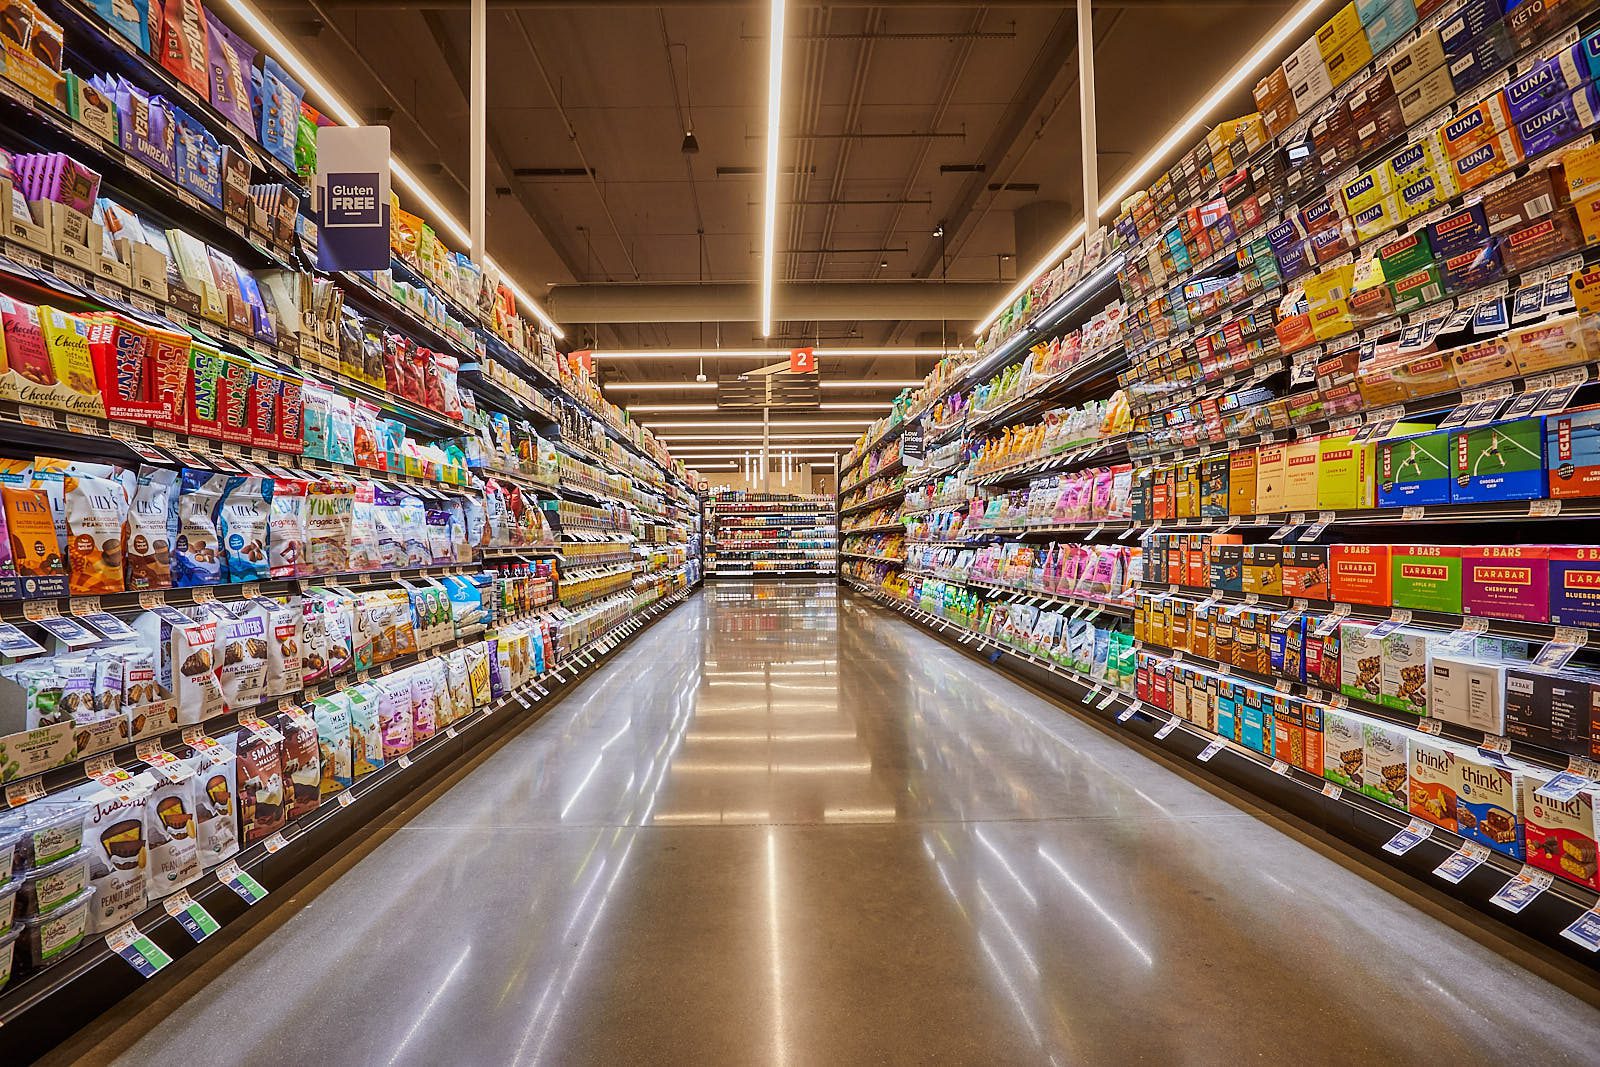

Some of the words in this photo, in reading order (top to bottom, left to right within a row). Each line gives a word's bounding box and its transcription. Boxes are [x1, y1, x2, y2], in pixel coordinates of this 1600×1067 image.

[1511, 1, 1543, 28] KETO
[226, 42, 251, 114] UNREAL
[1513, 71, 1549, 98] LUNA
[1449, 114, 1480, 137] LUNA
[1525, 108, 1561, 134] LUNA
[137, 137, 170, 170] UNREAL
[1394, 147, 1422, 168] LUNA
[1460, 149, 1493, 170] LUNA
[189, 171, 217, 200] UNREAL
[332, 185, 374, 197] Gluten
[1347, 178, 1373, 196] LUNA
[1405, 178, 1432, 198] LUNA
[332, 197, 375, 211] FREE
[1309, 203, 1330, 219] LUNA
[1357, 205, 1382, 222] LUNA
[1270, 226, 1292, 242] LUNA
[1238, 256, 1255, 269] KIND
[1282, 251, 1301, 265] LUNA
[1245, 278, 1262, 292] KIND
[1241, 323, 1257, 336] KIND
[576, 356, 583, 366] 1
[797, 353, 807, 366] 2
[1219, 401, 1239, 411] KIND
[905, 436, 923, 444] prices
[1559, 422, 1570, 452] CLIF
[1459, 436, 1468, 463] CLIF
[16, 500, 47, 514] LILY'S
[90, 494, 119, 511] LILY'S
[1351, 546, 1370, 554] BARS
[1417, 547, 1441, 556] BARS
[1483, 548, 1490, 557] 8
[1493, 548, 1521, 557] BARS
[1577, 549, 1584, 559] 8
[1565, 592, 1600, 600] BLUEBERR
[1240, 619, 1254, 629] KIND
[1286, 637, 1301, 648] KIND
[1246, 699, 1261, 708] KIND
[1274, 705, 1289, 715] KIND
[1274, 712, 1296, 725] PROTEIN
[28, 729, 50, 741] MINT
[1416, 749, 1449, 773] think!
[1462, 766, 1503, 793] think!
[101, 893, 123, 908] PEANUT
[117, 895, 142, 911] organic
